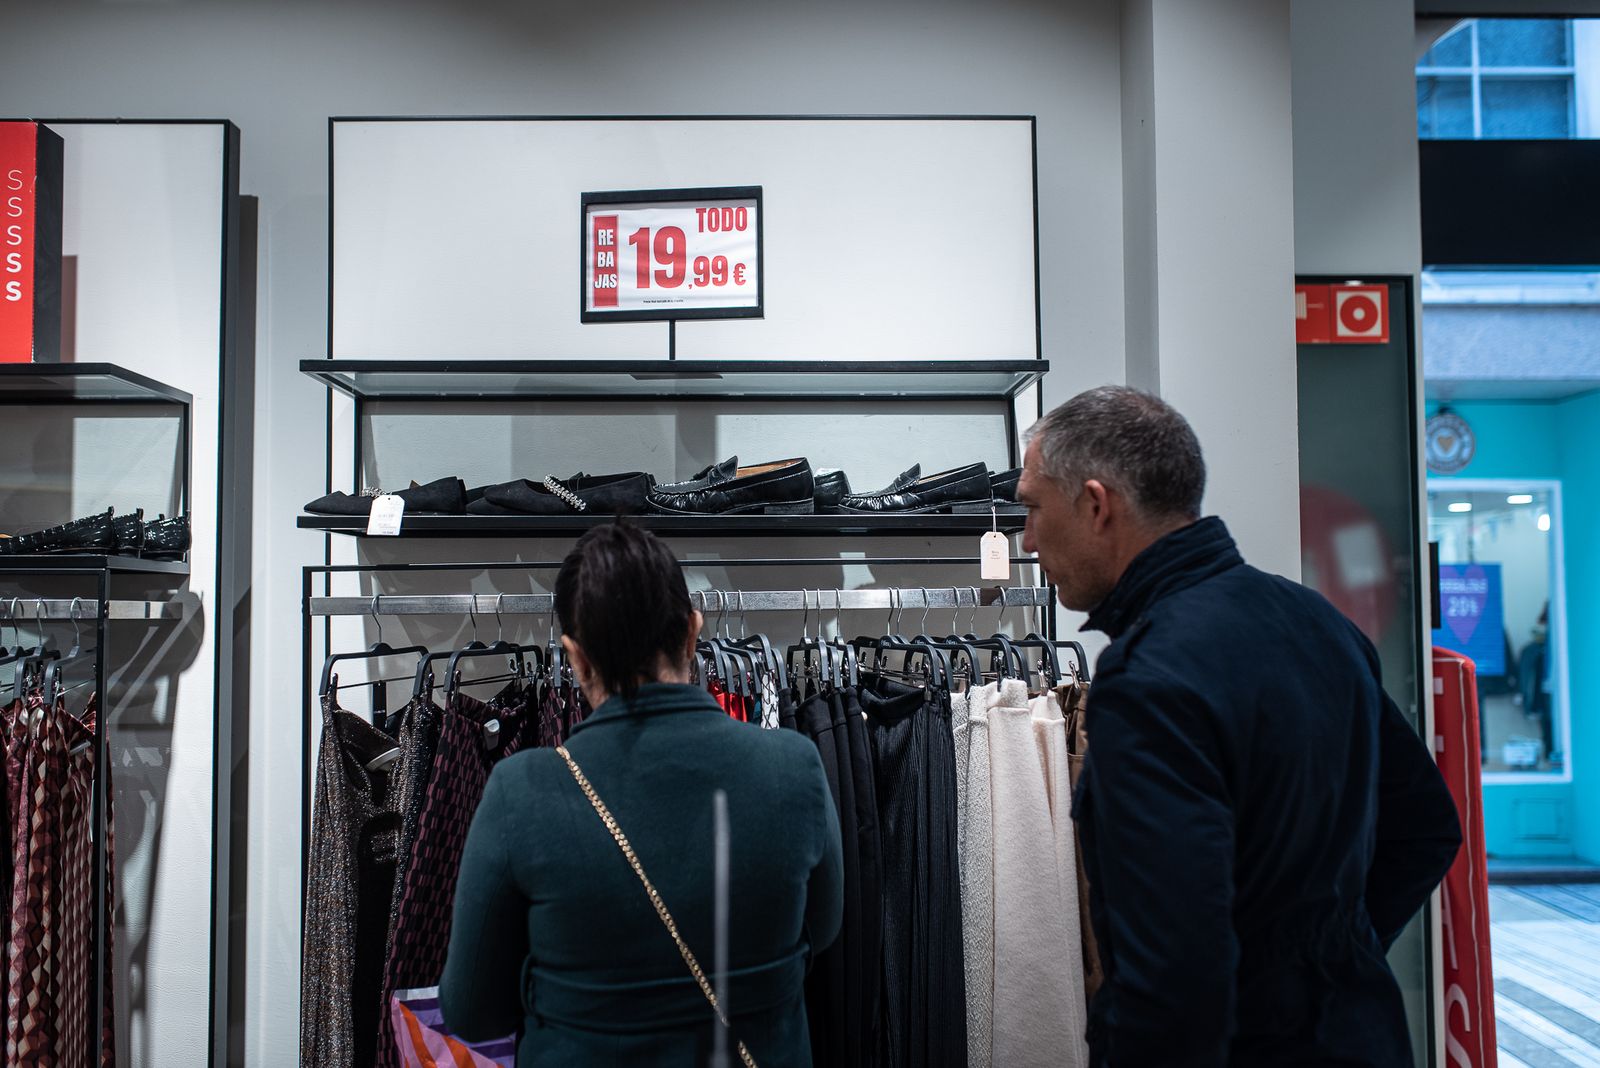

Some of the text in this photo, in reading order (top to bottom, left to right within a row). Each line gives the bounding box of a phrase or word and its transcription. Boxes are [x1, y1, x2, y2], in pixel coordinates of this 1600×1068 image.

[696, 207, 747, 233] TODO
[598, 228, 614, 246] RE
[598, 251, 615, 268] BA
[595, 273, 618, 289] JAS
